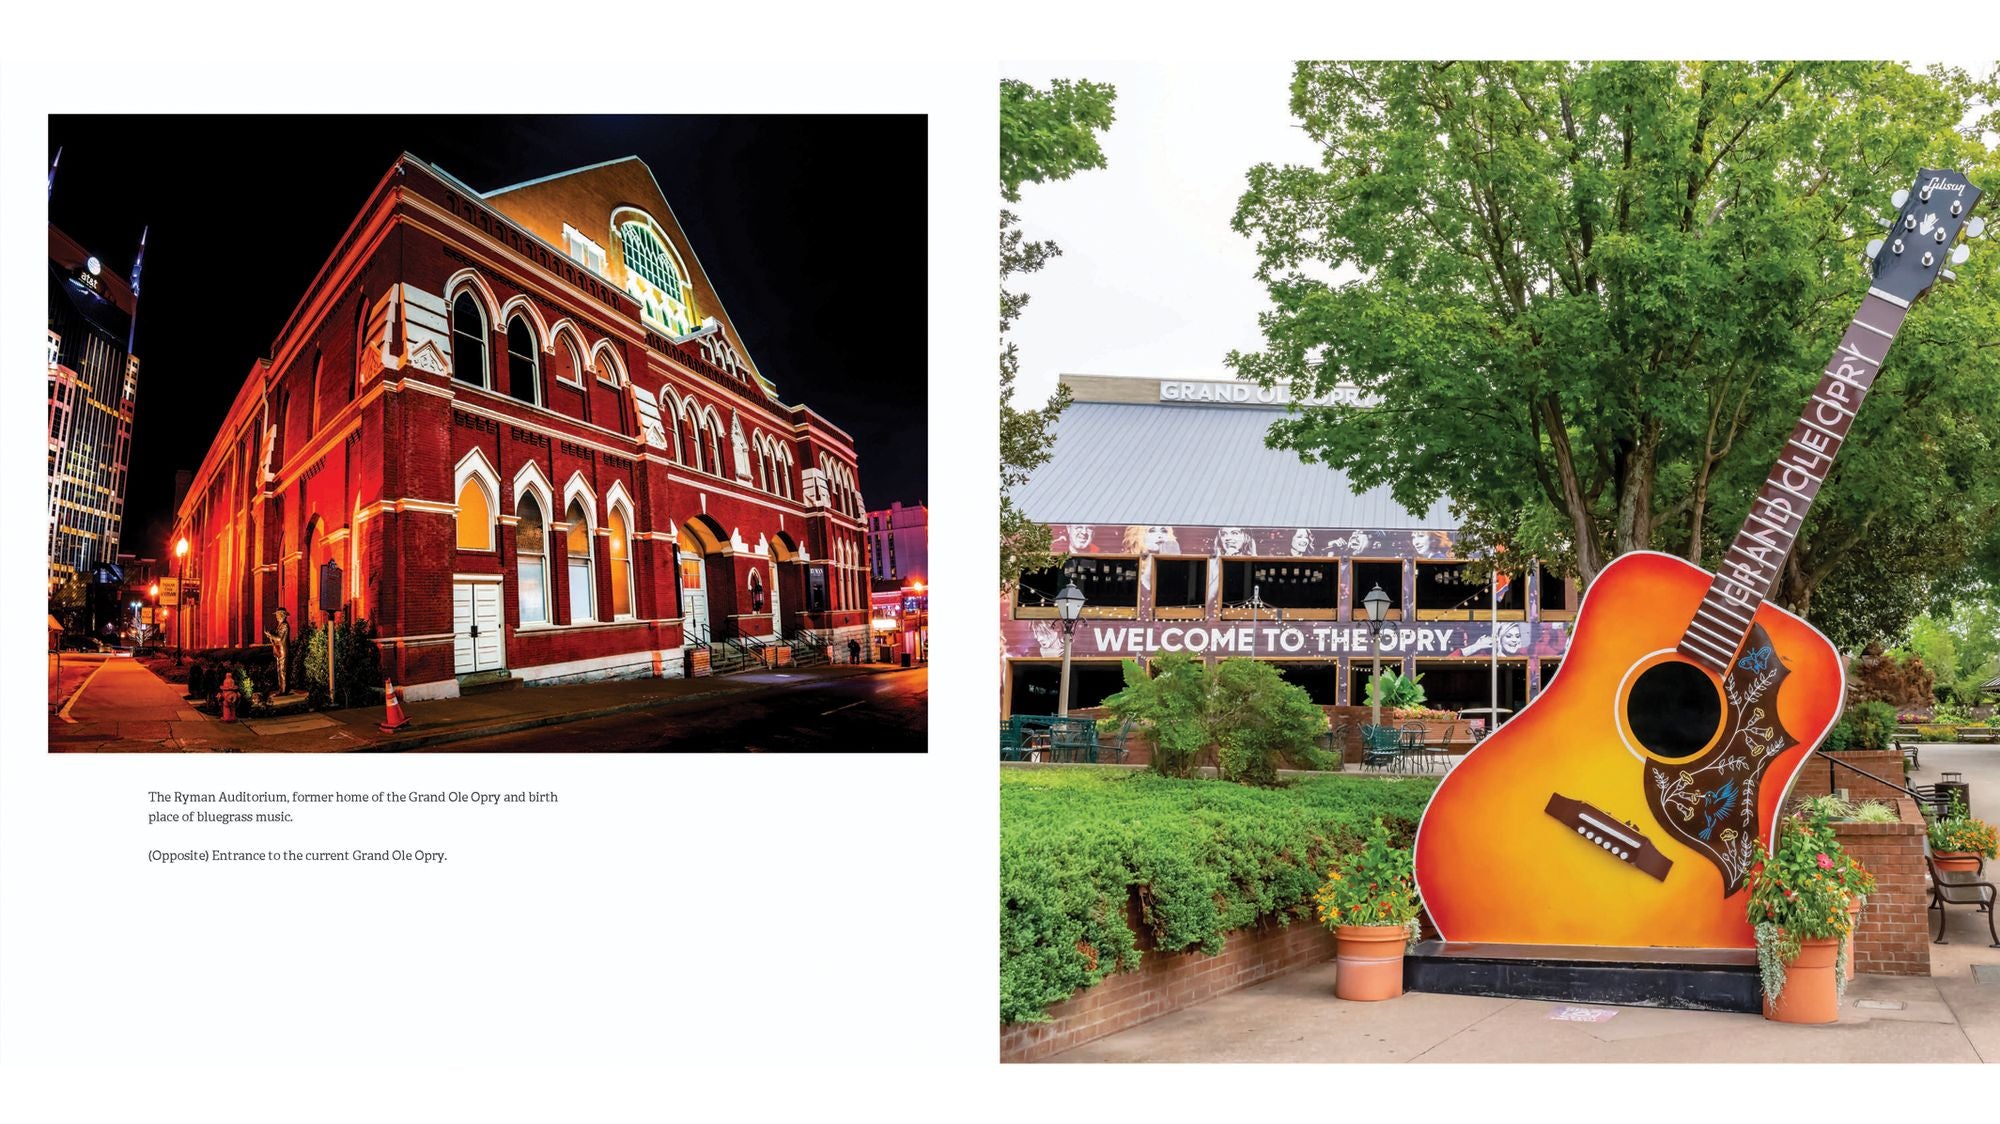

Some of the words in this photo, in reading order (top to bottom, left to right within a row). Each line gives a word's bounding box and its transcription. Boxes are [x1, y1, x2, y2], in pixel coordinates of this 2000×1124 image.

[1919, 176, 1966, 200] Gibson
[80, 271, 98, 289] at&t
[1161, 383, 1250, 402] GRAND
[1256, 385, 1306, 404] OL
[1723, 497, 1792, 607] GRAND
[1782, 428, 1830, 492] OLE
[1816, 342, 1865, 426] OPRY
[1093, 627, 1254, 652] WELCOME
[1262, 628, 1305, 652] TO
[1312, 628, 1368, 652] THE
[1378, 628, 1454, 652] OPRY
[148, 791, 172, 803] The
[174, 791, 216, 805] Ryman
[218, 791, 290, 804] Auditorium,
[292, 791, 334, 803] former
[336, 791, 369, 803] home
[371, 791, 385, 803] of
[387, 791, 407, 803] the
[408, 791, 446, 803] Grand
[448, 791, 469, 803] Ole
[470, 791, 501, 805] Opry
[503, 791, 526, 803] and
[528, 791, 559, 803] birth
[148, 811, 180, 825] place
[181, 811, 196, 822] of
[197, 811, 253, 825] bluegrass
[255, 811, 293, 822] music.
[148, 849, 209, 864] (Opposite)
[212, 850, 266, 861] Entrance
[268, 851, 281, 861] to
[283, 850, 304, 861] the
[305, 851, 350, 861] current
[352, 849, 390, 861] Grand
[391, 849, 413, 861] Ole
[414, 849, 448, 864] Opry.
